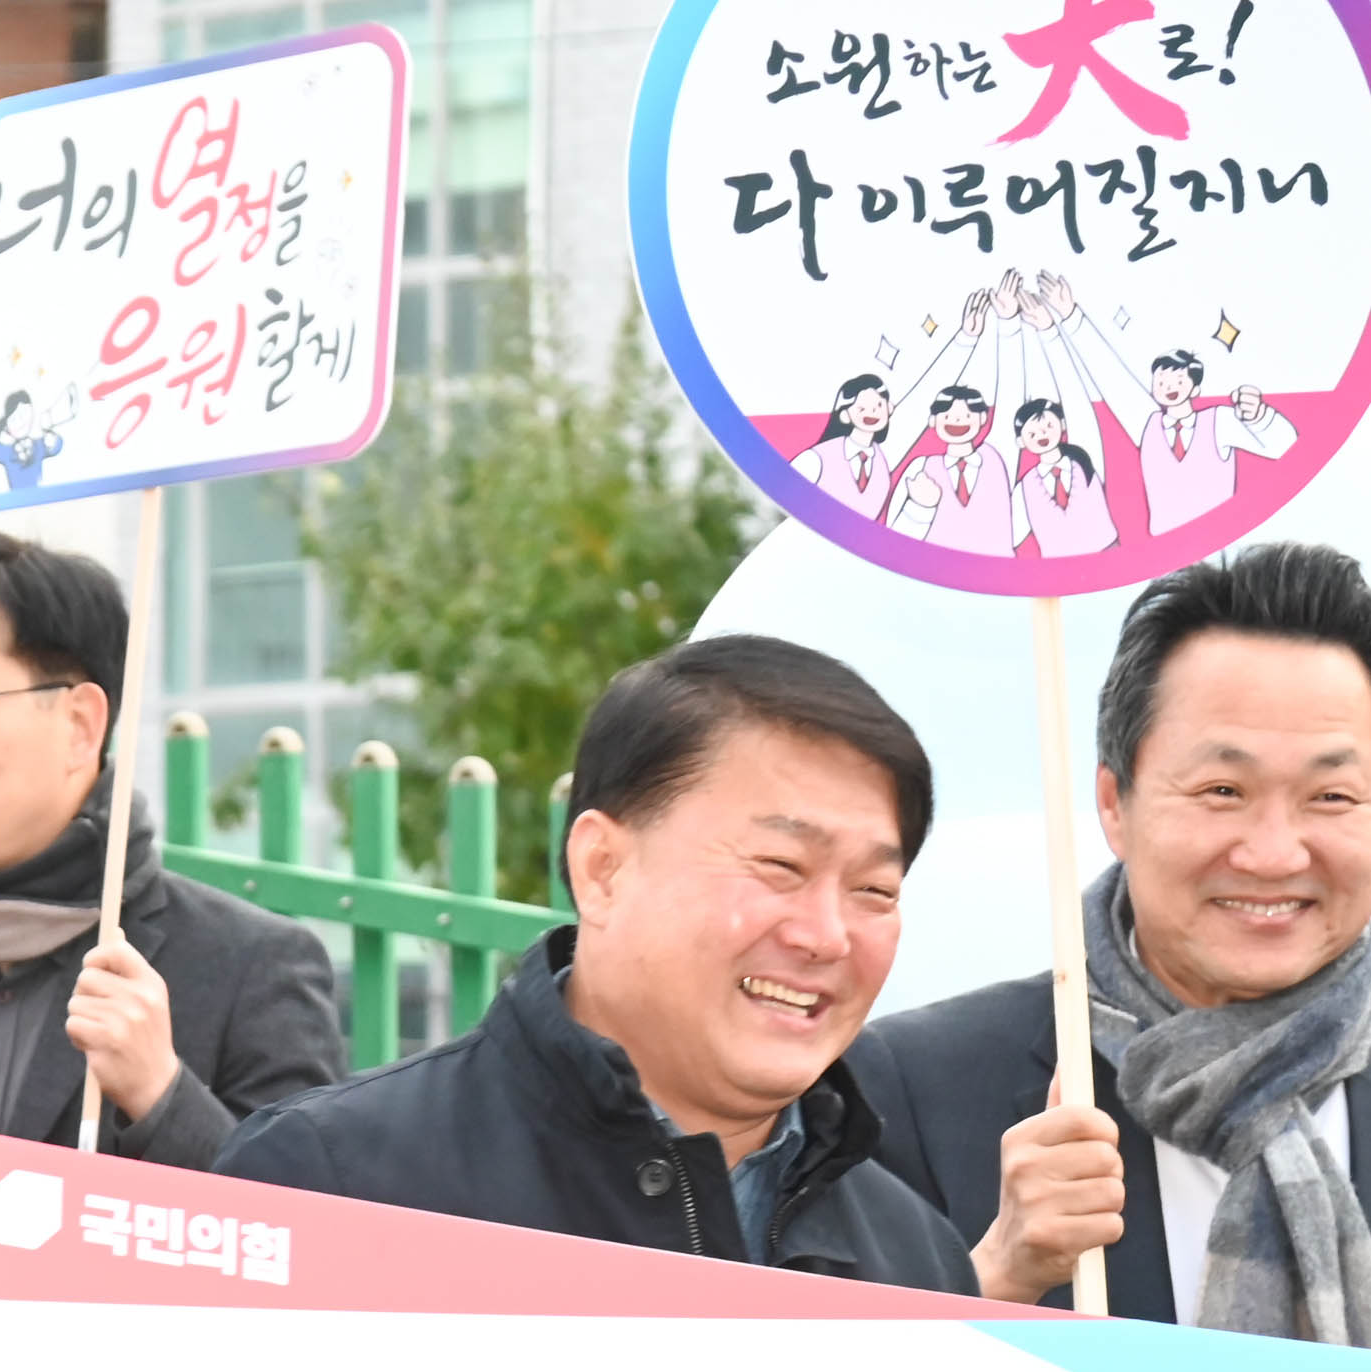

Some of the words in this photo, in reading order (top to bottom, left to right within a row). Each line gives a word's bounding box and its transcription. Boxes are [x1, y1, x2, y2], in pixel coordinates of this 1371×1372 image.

[766, 30, 997, 120] 소원하는
[151, 95, 309, 287] 열정을
[723, 148, 834, 282] 다
[857, 144, 1329, 262] 이루어질지니
[89, 288, 357, 449] 응원할게
[80, 1194, 292, 1286] 국민의힘
